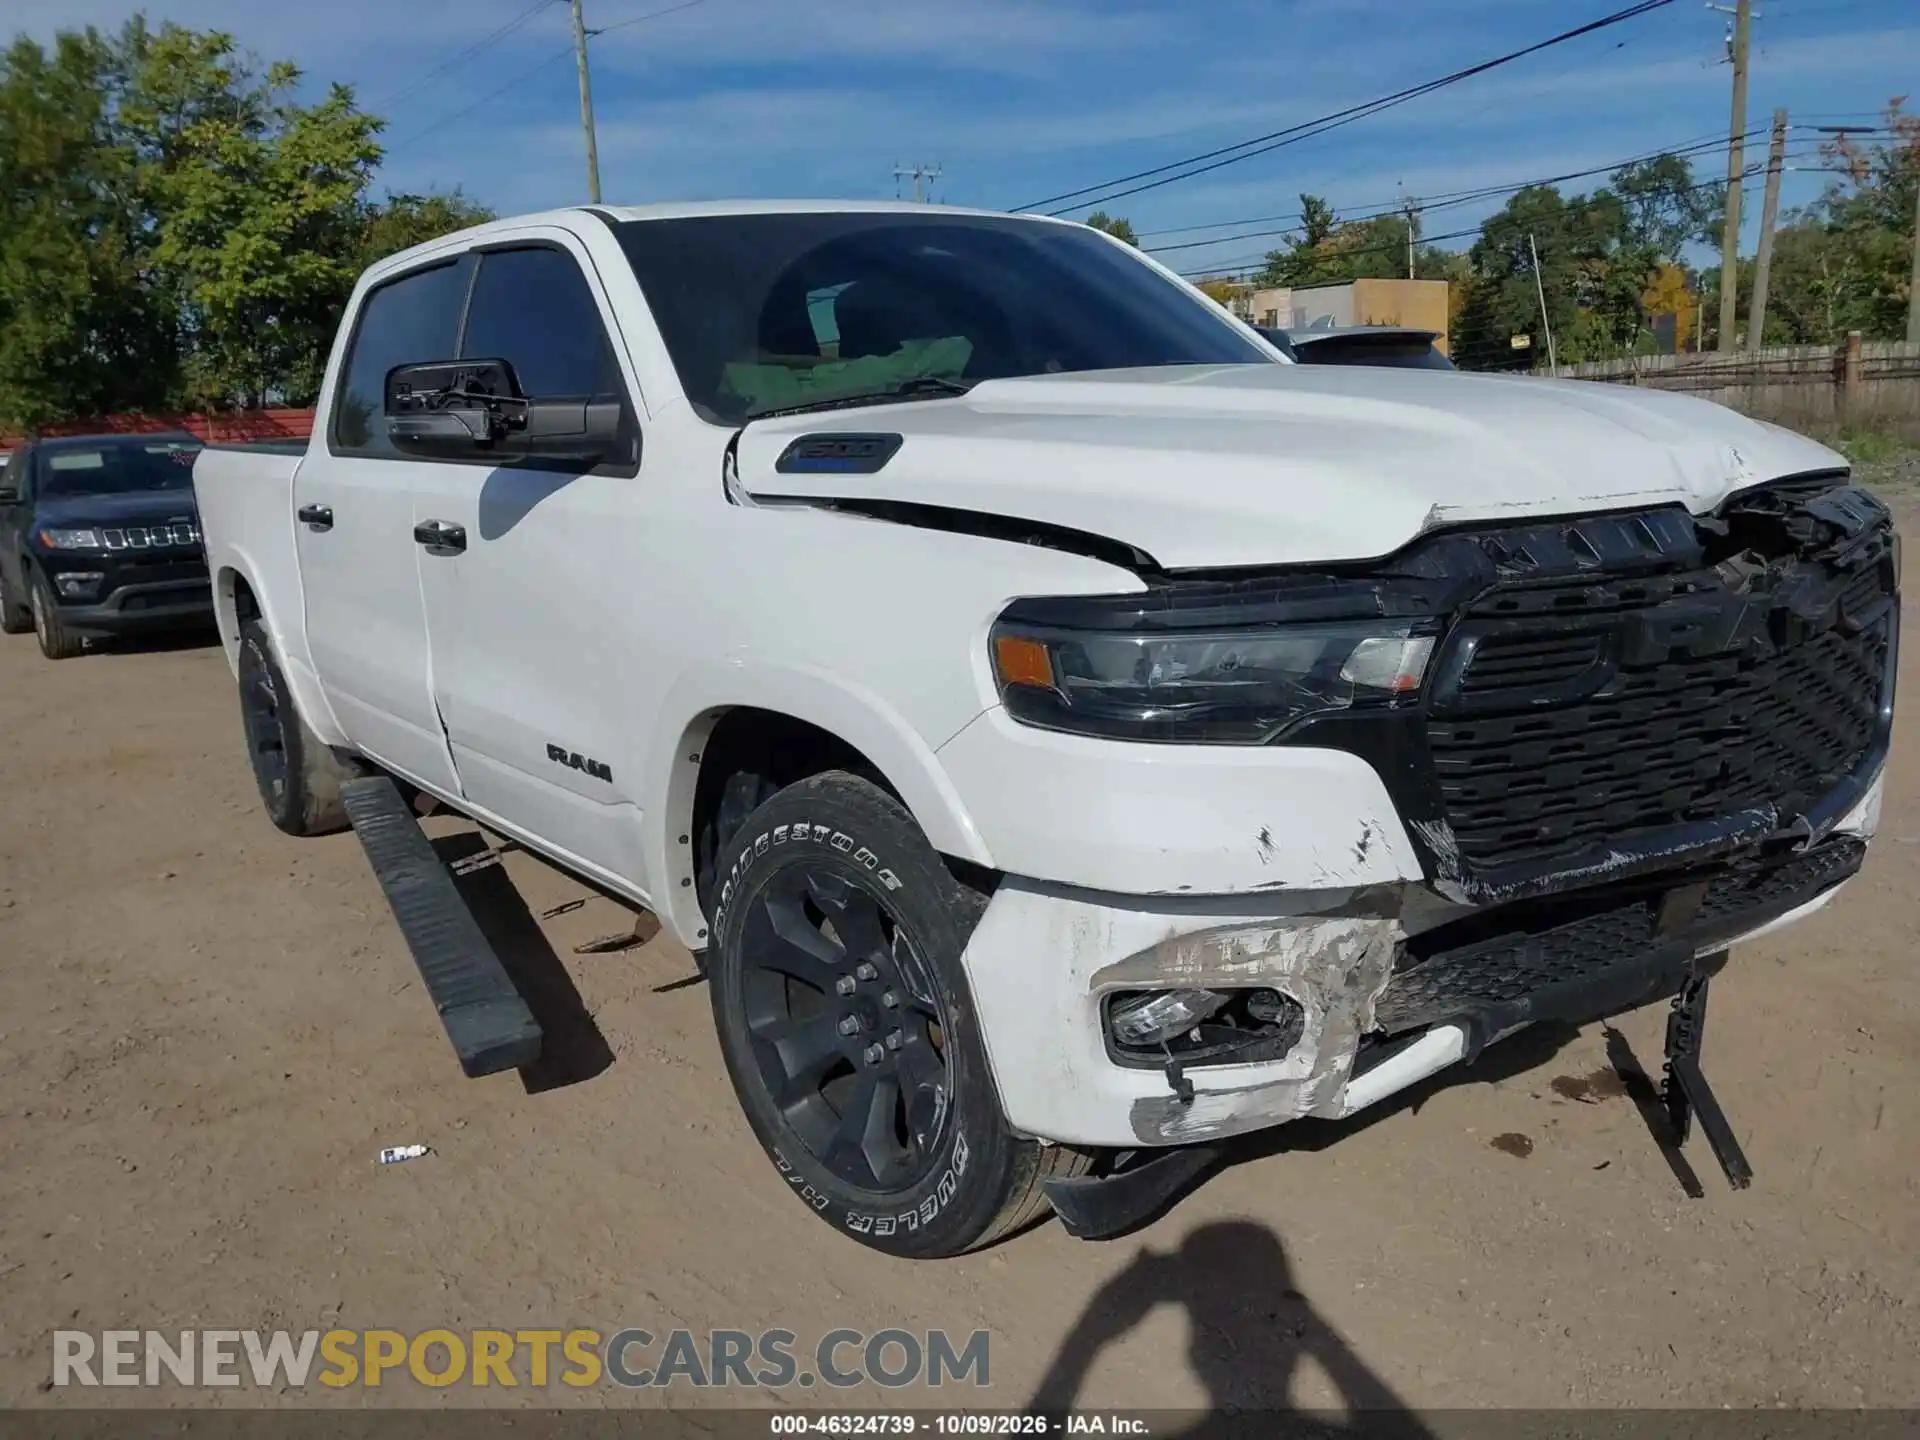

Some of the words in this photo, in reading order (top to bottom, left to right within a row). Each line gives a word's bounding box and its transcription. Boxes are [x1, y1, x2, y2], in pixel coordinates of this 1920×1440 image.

[546, 743, 613, 784] RAM
[714, 822, 903, 948] BRIDGESTONE
[846, 1131, 969, 1236] DUELER
